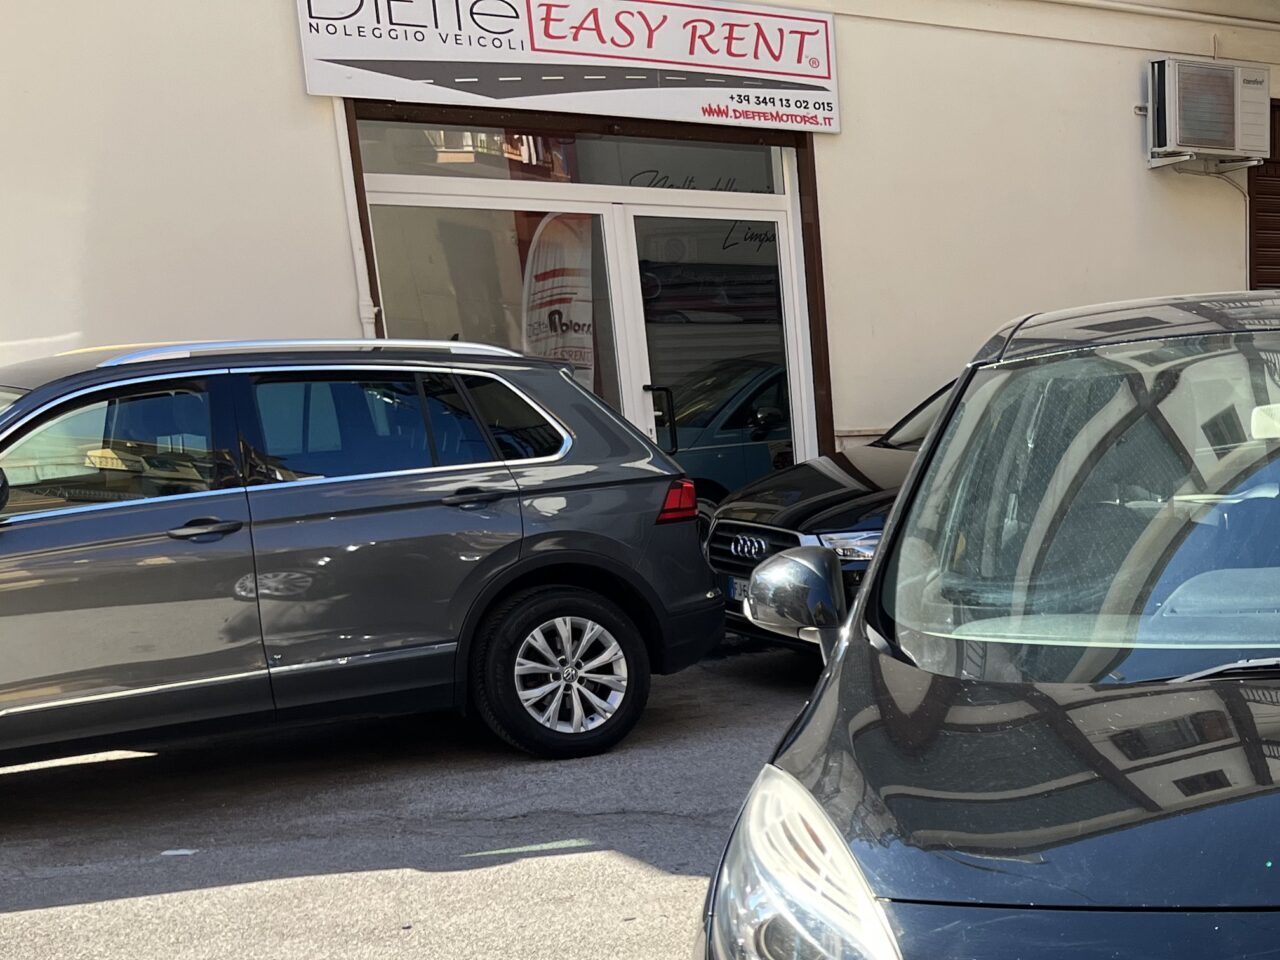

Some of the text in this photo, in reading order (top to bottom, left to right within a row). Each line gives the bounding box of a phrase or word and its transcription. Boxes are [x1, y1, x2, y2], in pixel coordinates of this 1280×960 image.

[309, 22, 525, 51] NOLEGGIO VEICOLI
[538, 2, 668, 49] EASY
[682, 18, 820, 65] RENT
[729, 94, 833, 112] +39 349 13 02 015
